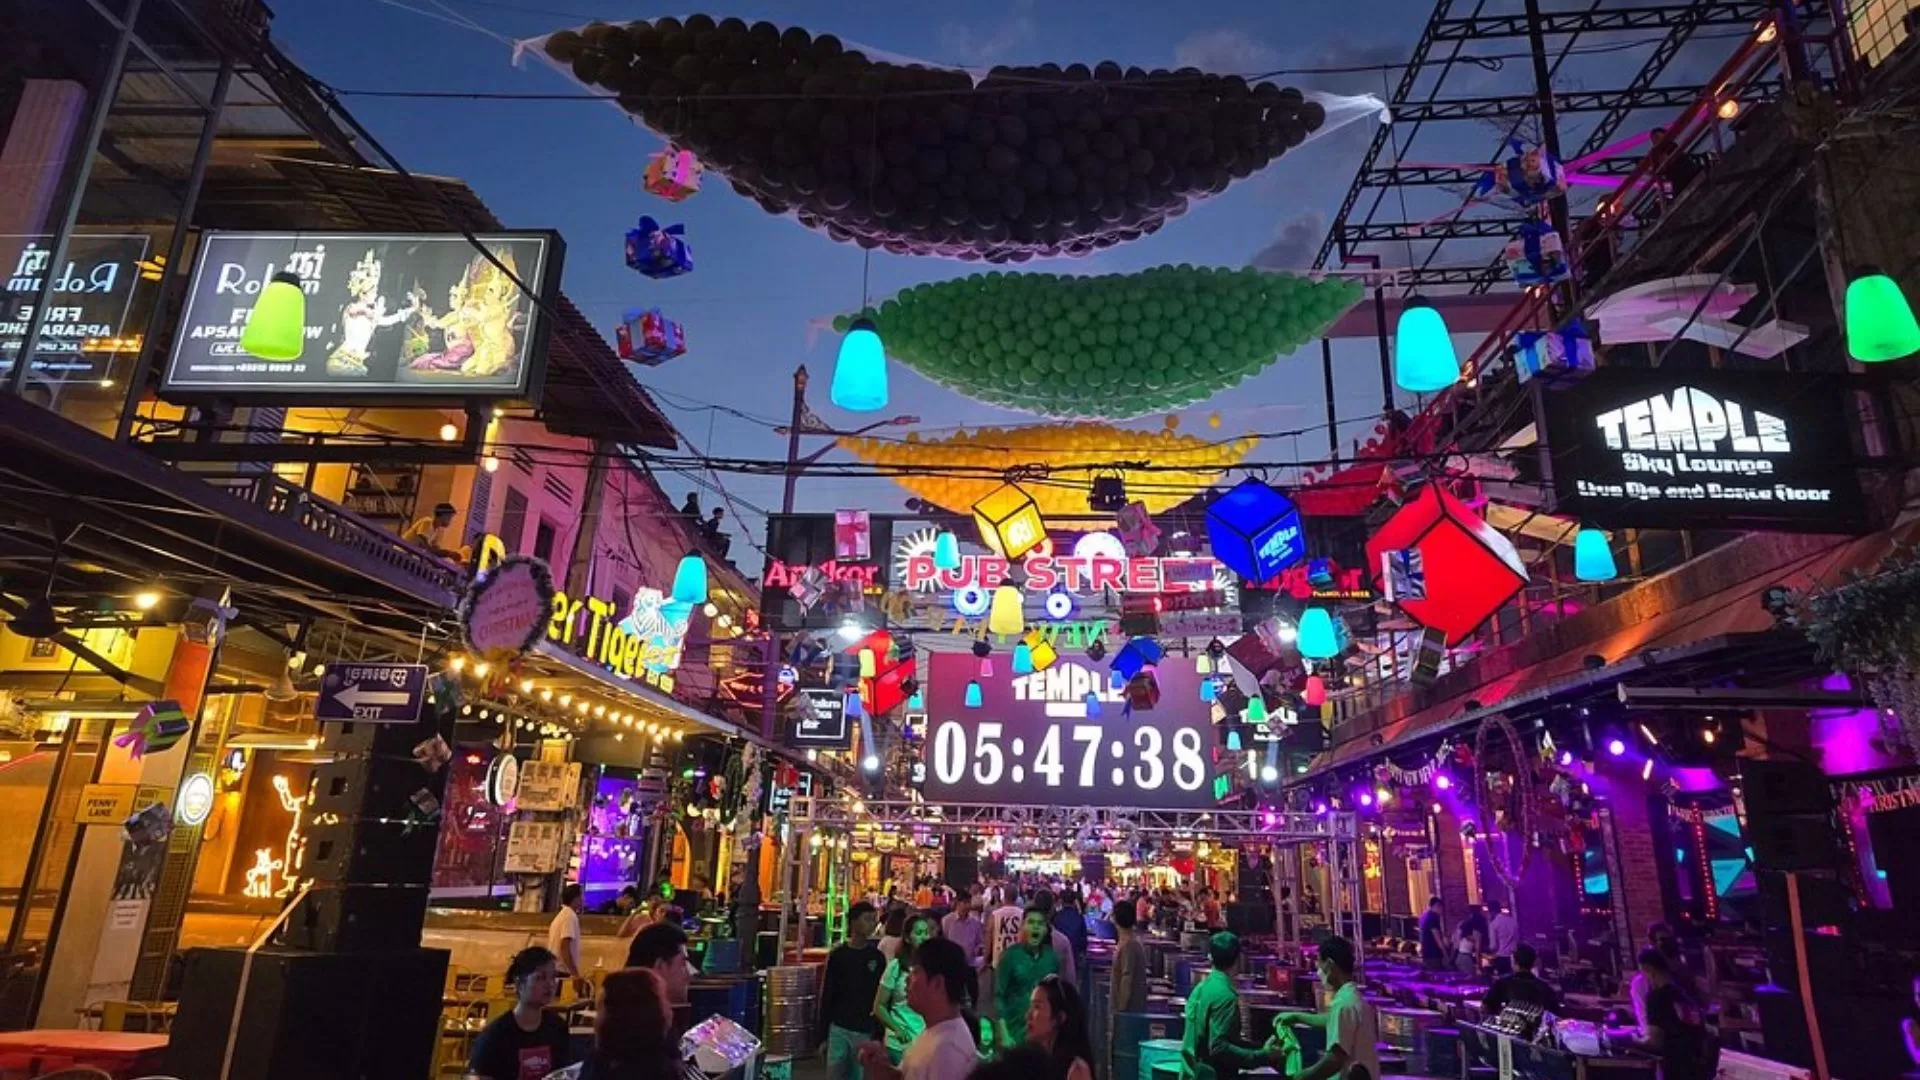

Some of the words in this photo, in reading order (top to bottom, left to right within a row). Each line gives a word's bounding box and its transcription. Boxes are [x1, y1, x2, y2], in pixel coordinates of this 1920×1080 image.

[1596, 385, 1791, 452] TEMPLE
[1622, 452, 1674, 476] Sky
[1676, 452, 1773, 475] Lounge
[1664, 483, 1705, 499] and
[905, 555, 1013, 591] PUB
[352, 706, 383, 719] EXIT
[934, 720, 1206, 791] 05:47:38
[88, 808, 112, 817] LANE
